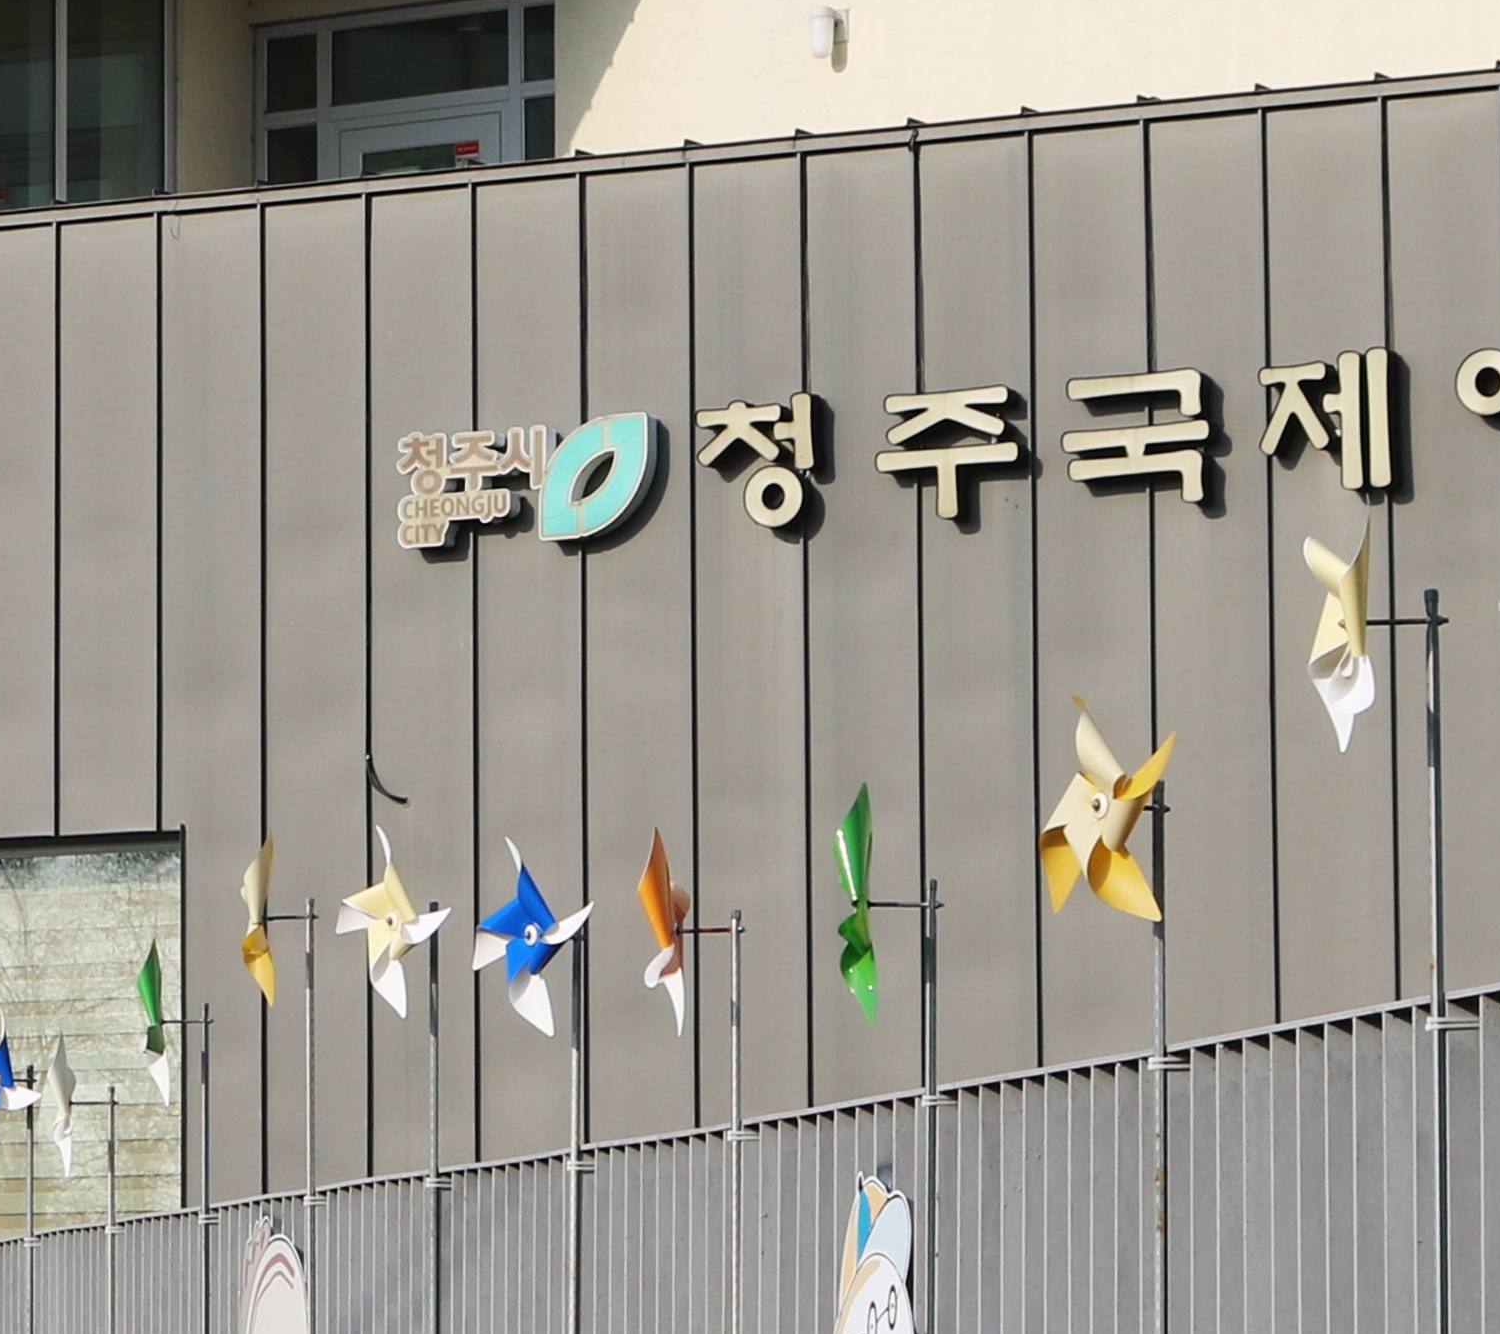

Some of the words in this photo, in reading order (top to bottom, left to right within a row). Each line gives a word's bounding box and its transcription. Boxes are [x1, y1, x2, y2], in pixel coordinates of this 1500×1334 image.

[399, 427, 544, 494] 청주시
[402, 493, 508, 521] CHEONGJU
[402, 521, 446, 546] CITY
